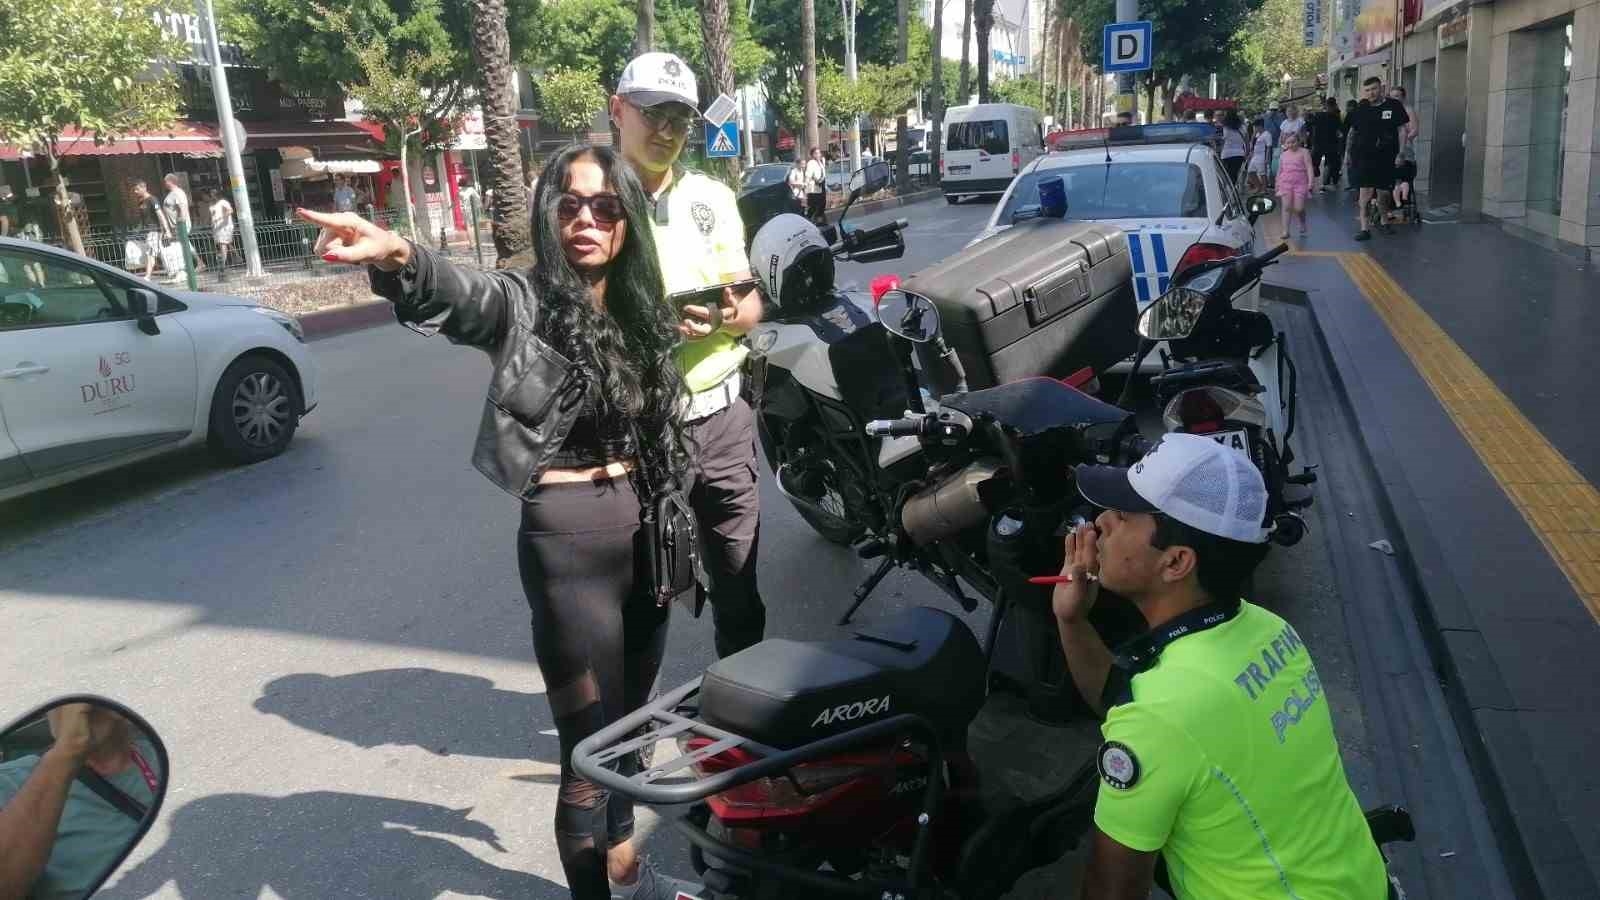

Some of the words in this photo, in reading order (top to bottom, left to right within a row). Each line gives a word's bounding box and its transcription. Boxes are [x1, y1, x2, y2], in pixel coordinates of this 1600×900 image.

[1117, 34, 1138, 60] D
[80, 374, 136, 403] DURU
[810, 694, 892, 728] ARORA
